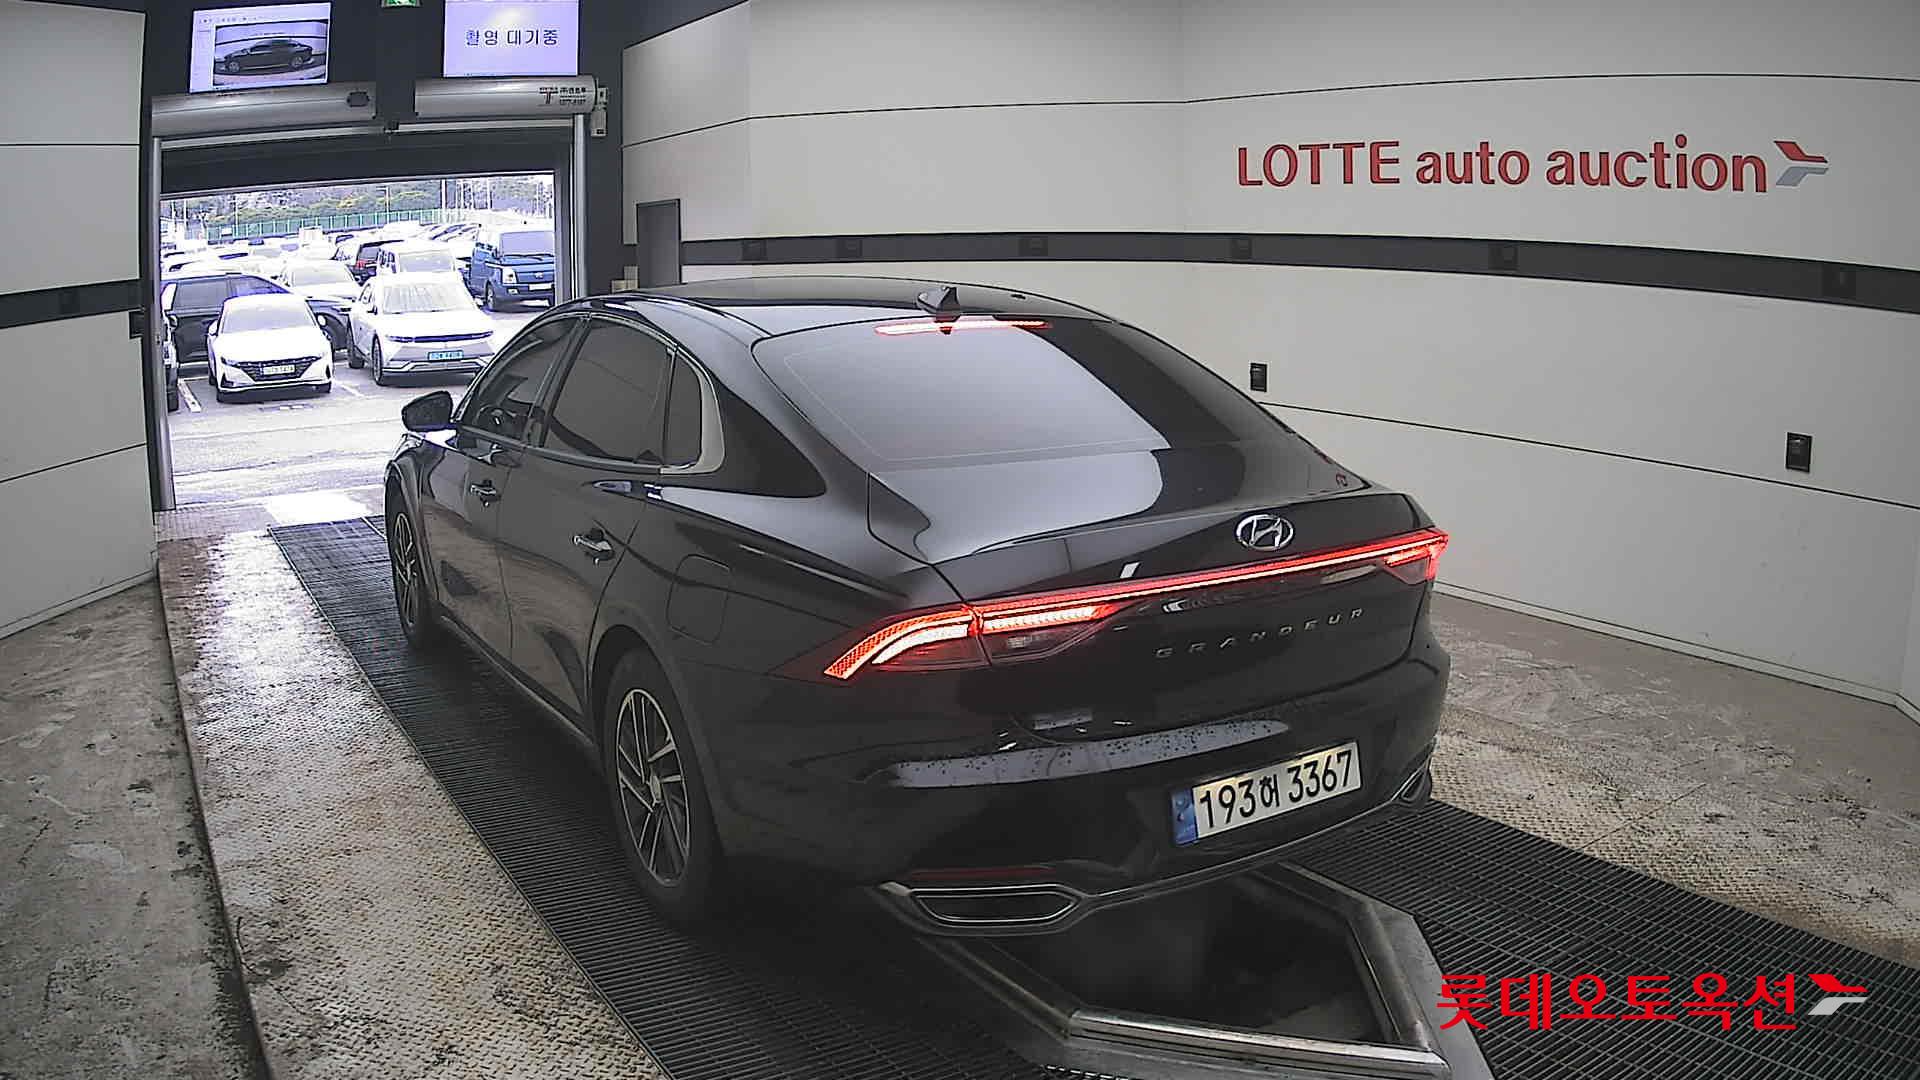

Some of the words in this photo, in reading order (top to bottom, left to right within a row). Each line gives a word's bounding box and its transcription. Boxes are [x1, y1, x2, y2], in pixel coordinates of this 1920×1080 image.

[507, 29, 558, 46] 대기중
[1238, 140, 1400, 187] LOTTE
[1415, 141, 1530, 186] auto
[1546, 133, 1768, 193] auction
[1155, 608, 1363, 658] GRANDEUR
[1200, 774, 1280, 829] 193허
[1287, 750, 1352, 803] 3367
